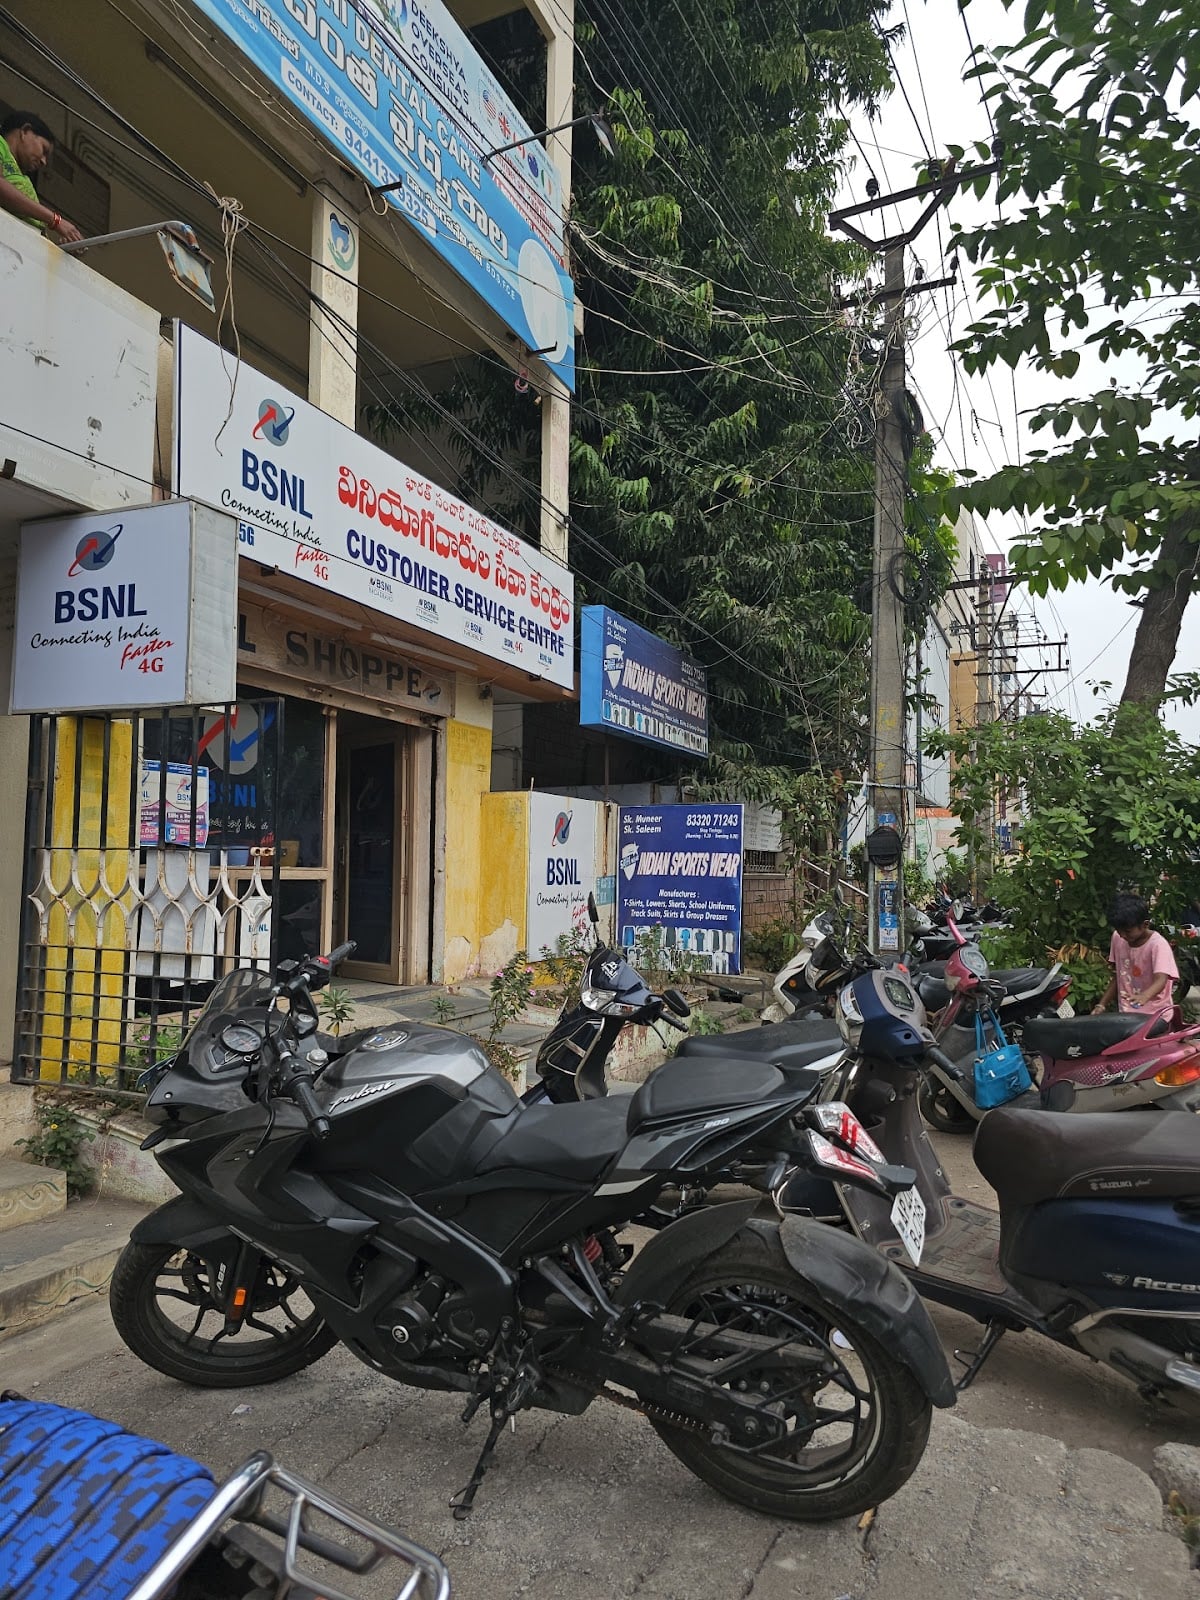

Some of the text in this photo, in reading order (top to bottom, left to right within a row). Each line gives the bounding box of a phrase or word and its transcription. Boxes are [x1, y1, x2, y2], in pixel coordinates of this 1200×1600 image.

[411, 0, 467, 83] DEEKSHYA
[411, 21, 469, 105] OVERSEAS
[287, 70, 338, 130] CONTACT:
[355, 13, 432, 131] DENTAL
[436, 118, 482, 190] CARE
[388, 89, 508, 260] వైద్యశాల
[241, 448, 313, 520] BSNL
[221, 488, 322, 547] Connecting India
[238, 522, 255, 546] 5G
[338, 465, 570, 631] వినియోగదారుల సేవా కేంద్రం
[295, 543, 331, 568] Faster
[313, 563, 329, 581] 4G
[346, 528, 565, 657] CUSTOMER SERVICE CENTRE
[376, 579, 393, 594] BSNL
[54, 583, 147, 625] BSNL
[423, 599, 438, 614] BSNL
[31, 622, 161, 650] Connecting India
[120, 638, 174, 670] Faster
[138, 657, 164, 674] 4G
[285, 629, 422, 699] SHOPPE
[622, 658, 655, 697] INDIAN
[654, 674, 685, 711] SPORTS
[685, 689, 706, 720] WEAR
[623, 814, 662, 824] Sk. Muneer
[623, 825, 662, 834] Sk. Saleem
[686, 814, 739, 827] 83320 71243
[546, 857, 581, 886] BSNL
[637, 852, 672, 876] INDIAN
[670, 852, 710, 877] SPORTS
[709, 852, 740, 878] WEAR
[537, 891, 585, 908] Connecting India
[623, 898, 737, 912] T-Shirts, Lowers, Shorts, School Uniforms,
[658, 889, 697, 899] Manufactures
[630, 909, 728, 921] Track Suits, Skirts & Group Dresses
[216, 1262, 227, 1293] ABS
